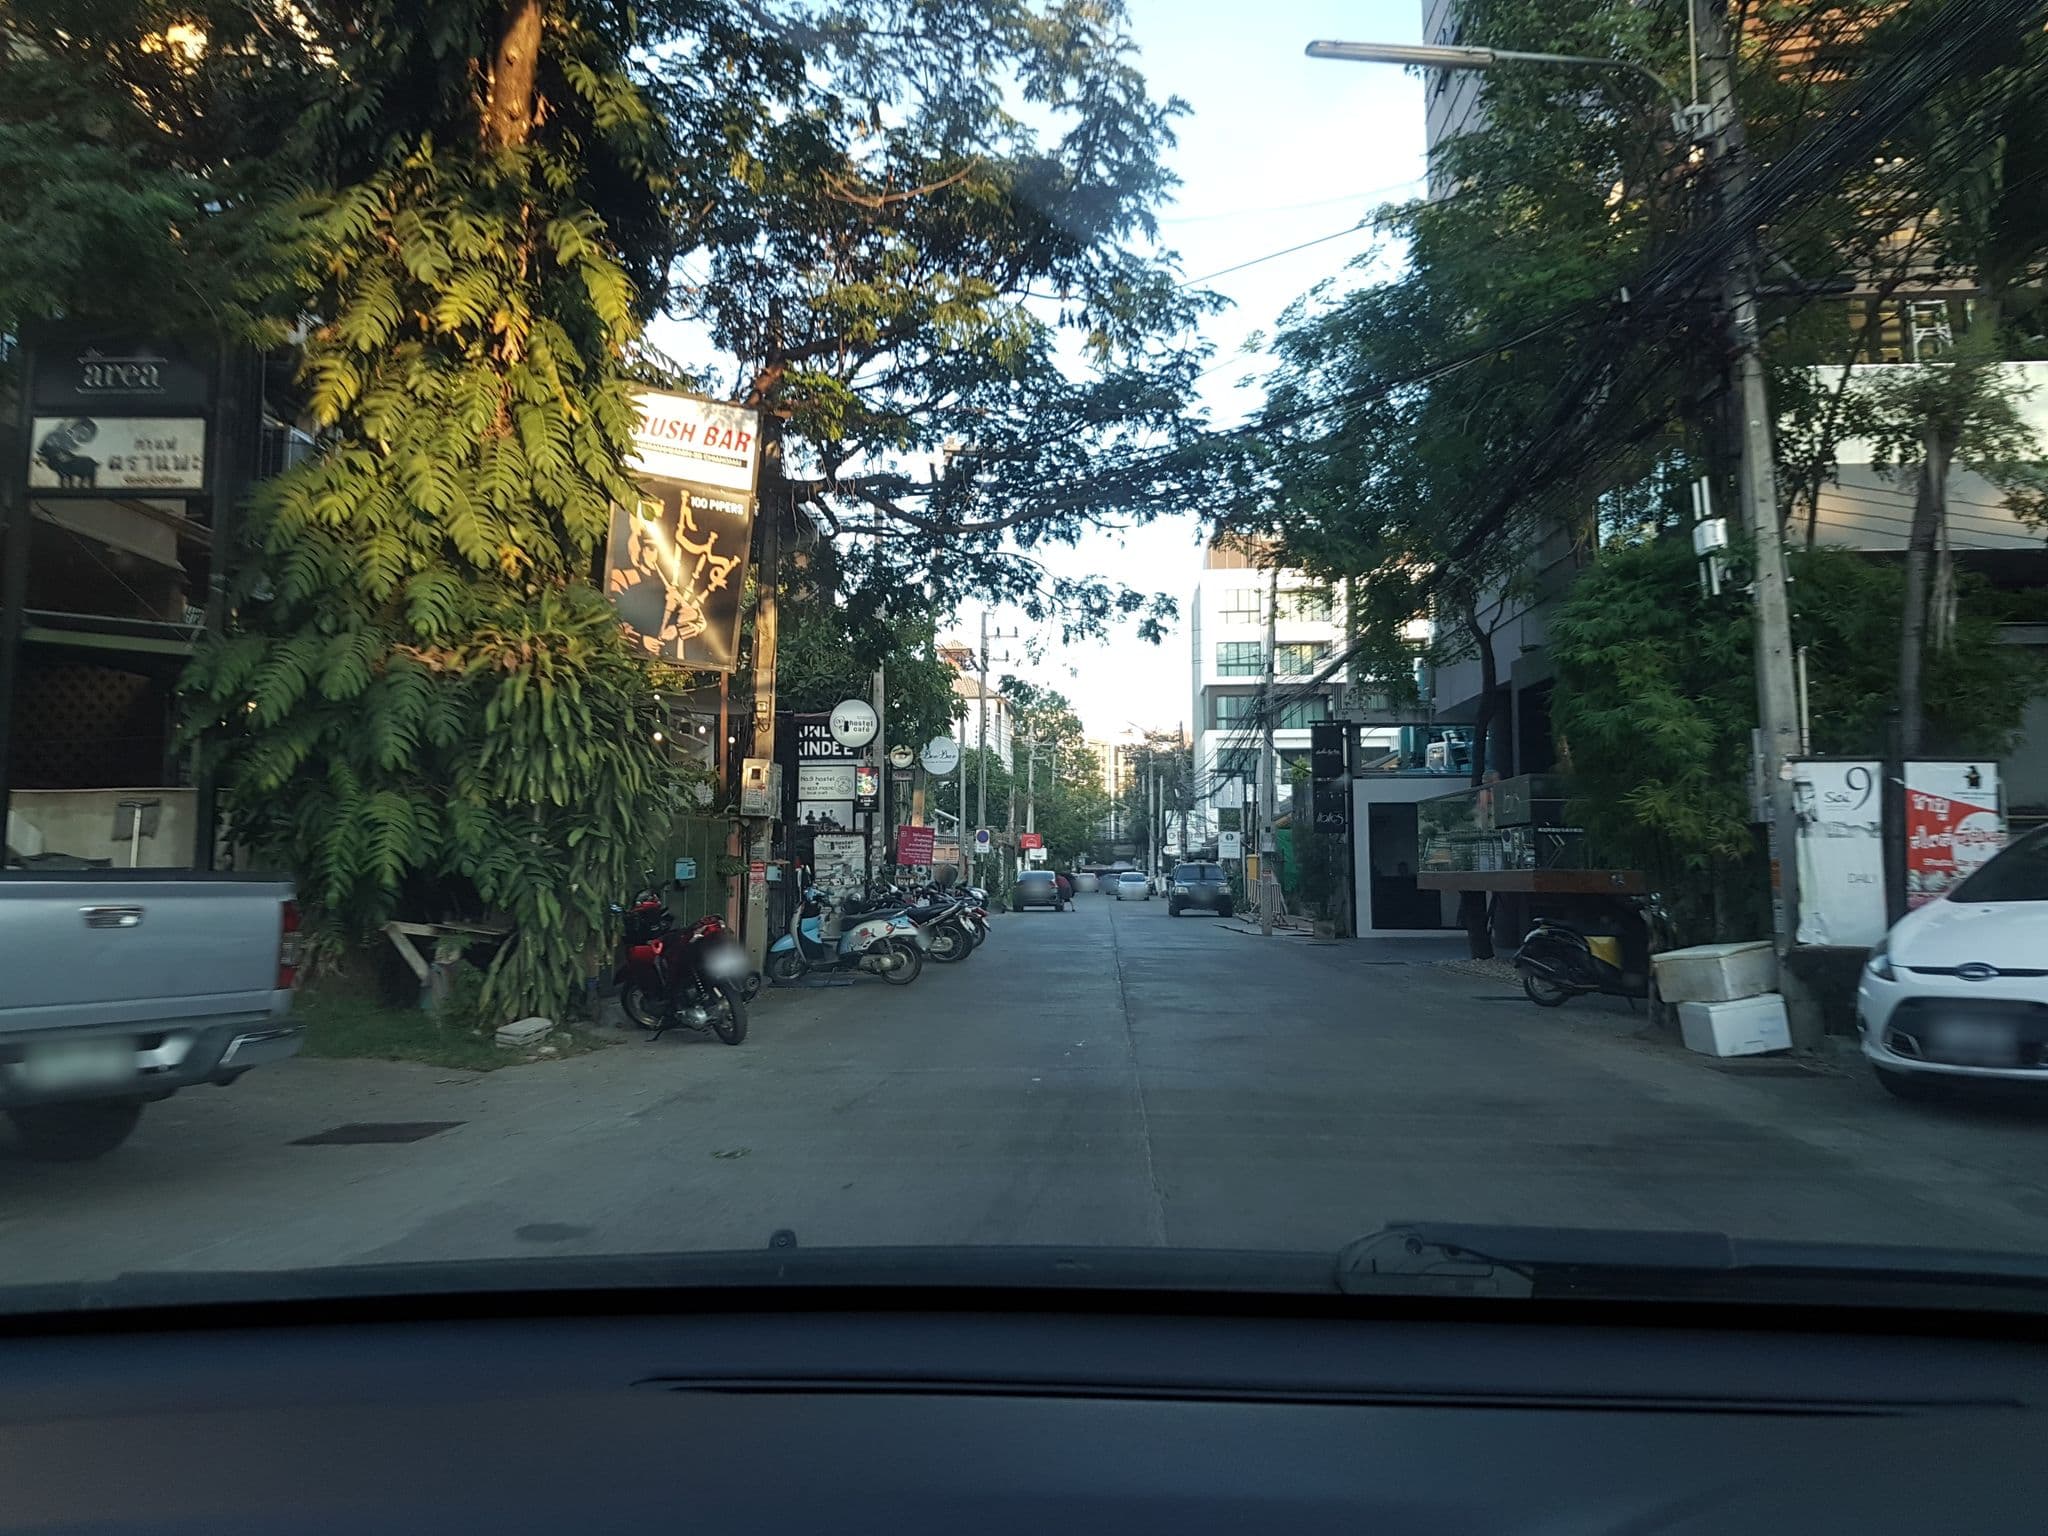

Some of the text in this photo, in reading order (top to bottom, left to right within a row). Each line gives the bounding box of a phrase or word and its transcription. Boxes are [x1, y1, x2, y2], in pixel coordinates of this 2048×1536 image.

[83, 363, 161, 388] area
[703, 425, 752, 453] BAR
[690, 496, 744, 516] 100 PIPERS
[1845, 766, 1873, 811] 9
